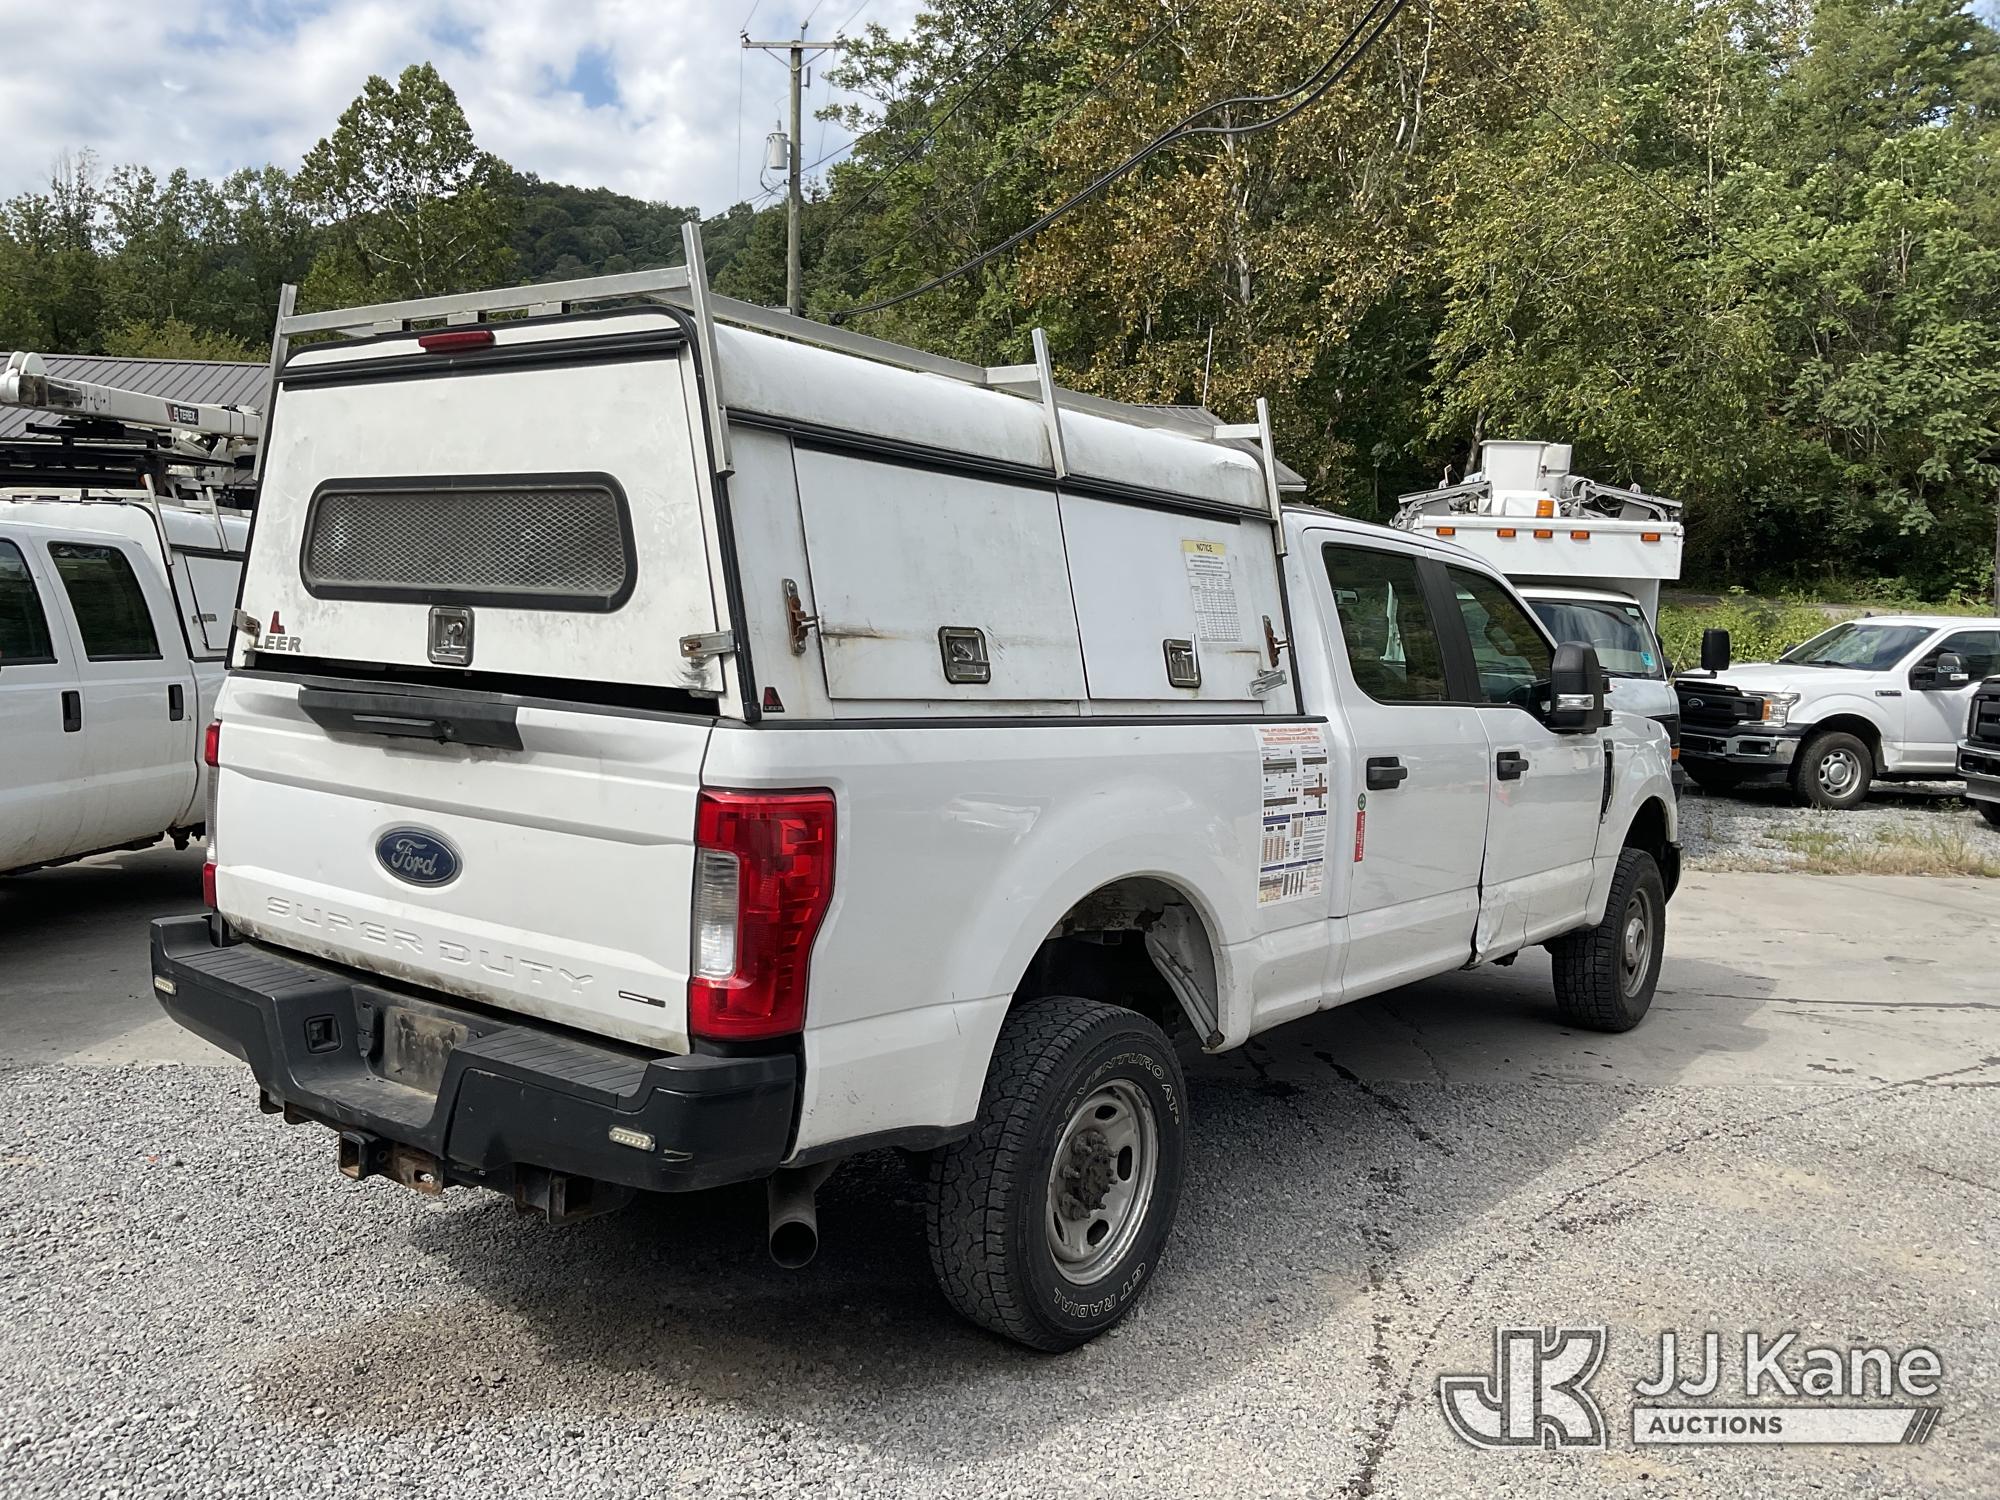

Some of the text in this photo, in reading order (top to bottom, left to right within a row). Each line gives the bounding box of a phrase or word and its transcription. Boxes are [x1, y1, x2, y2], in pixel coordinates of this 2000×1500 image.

[179, 408, 197, 421] TEREX
[1195, 543, 1213, 553] NOTICE
[254, 634, 302, 653] LEER
[391, 838, 438, 875] Ford
[267, 896, 594, 994] SUPER DUTY
[1053, 1262, 1146, 1318] GT RADIAL
